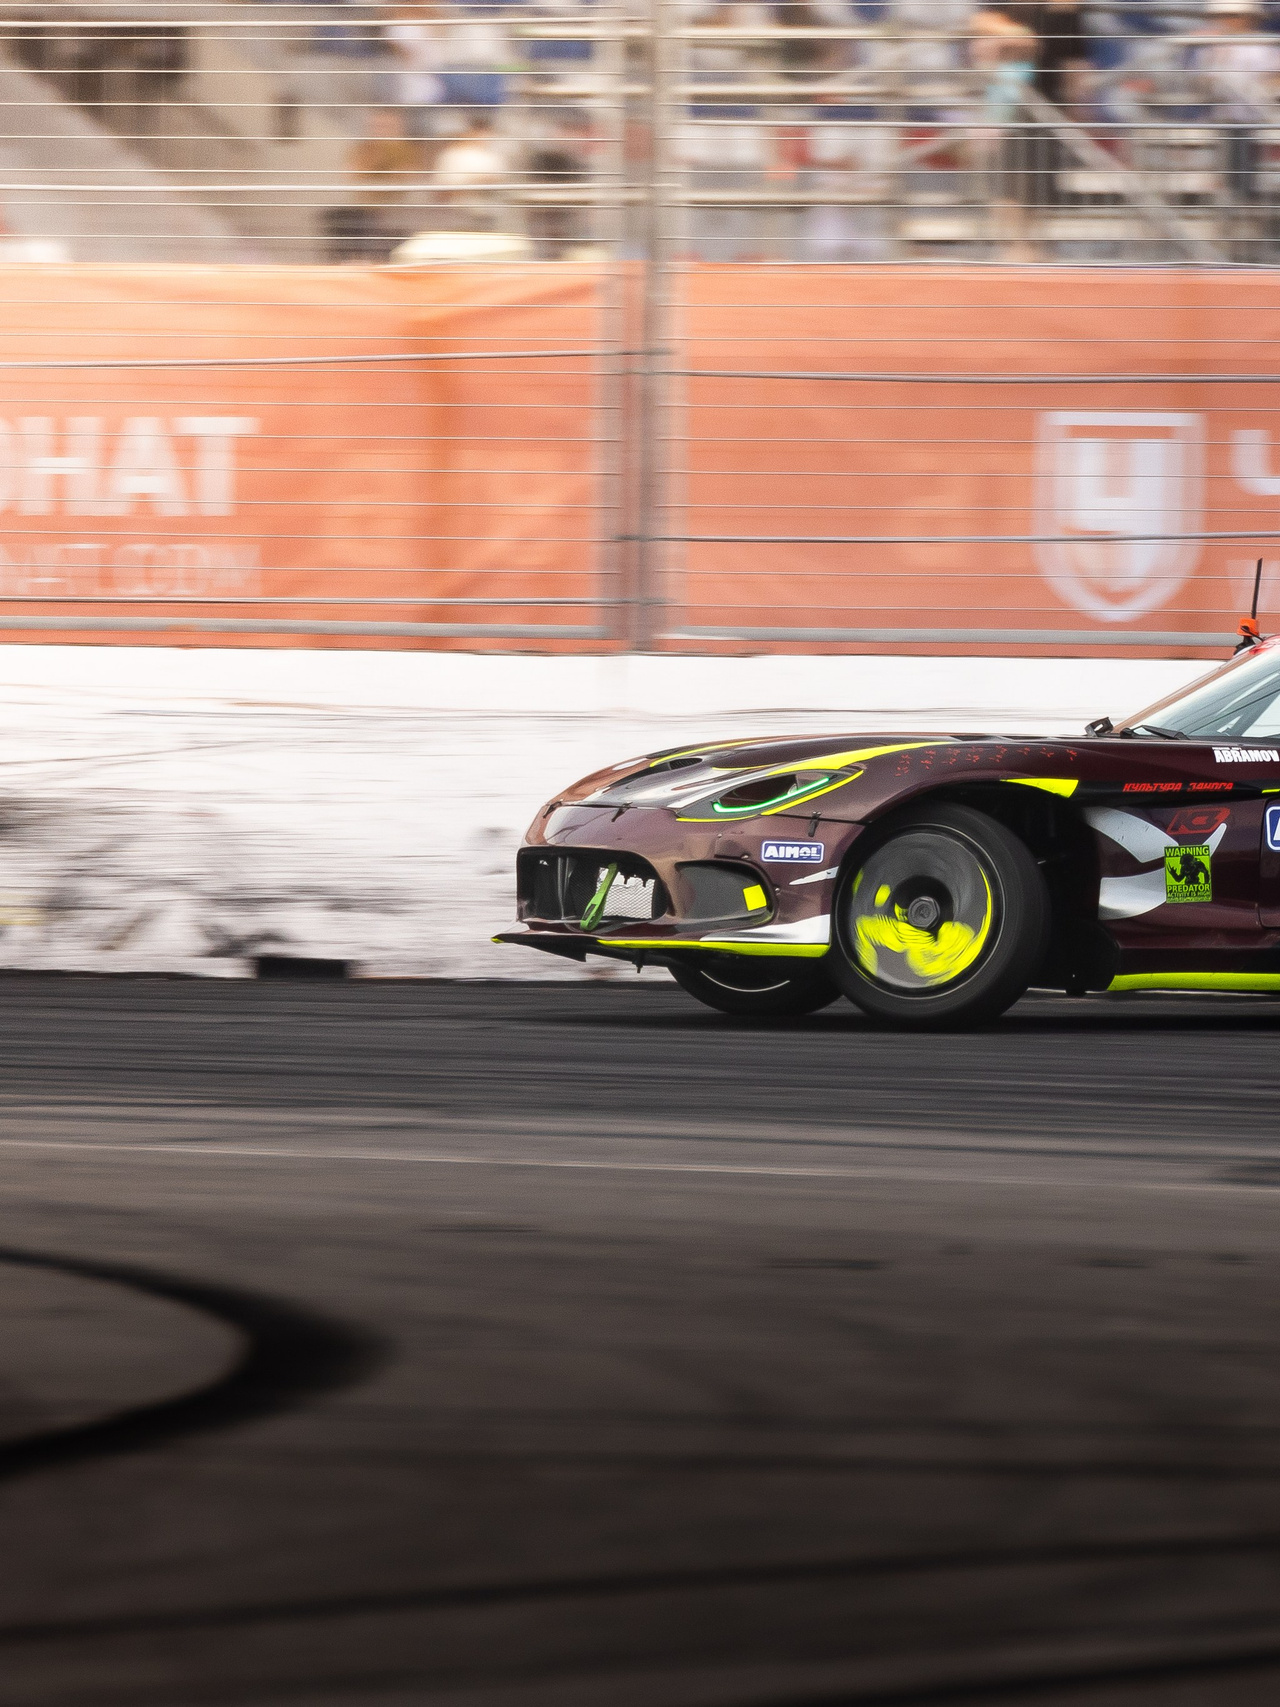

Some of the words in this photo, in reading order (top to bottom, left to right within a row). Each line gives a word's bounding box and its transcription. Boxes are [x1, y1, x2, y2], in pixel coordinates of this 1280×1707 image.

[0, 416, 260, 516] НАТ
[1122, 782, 1183, 793] КУЛЬТУРА
[764, 845, 821, 859] AIMOL
[1165, 846, 1209, 857] WARNING
[1167, 884, 1210, 892] PREDATOR
